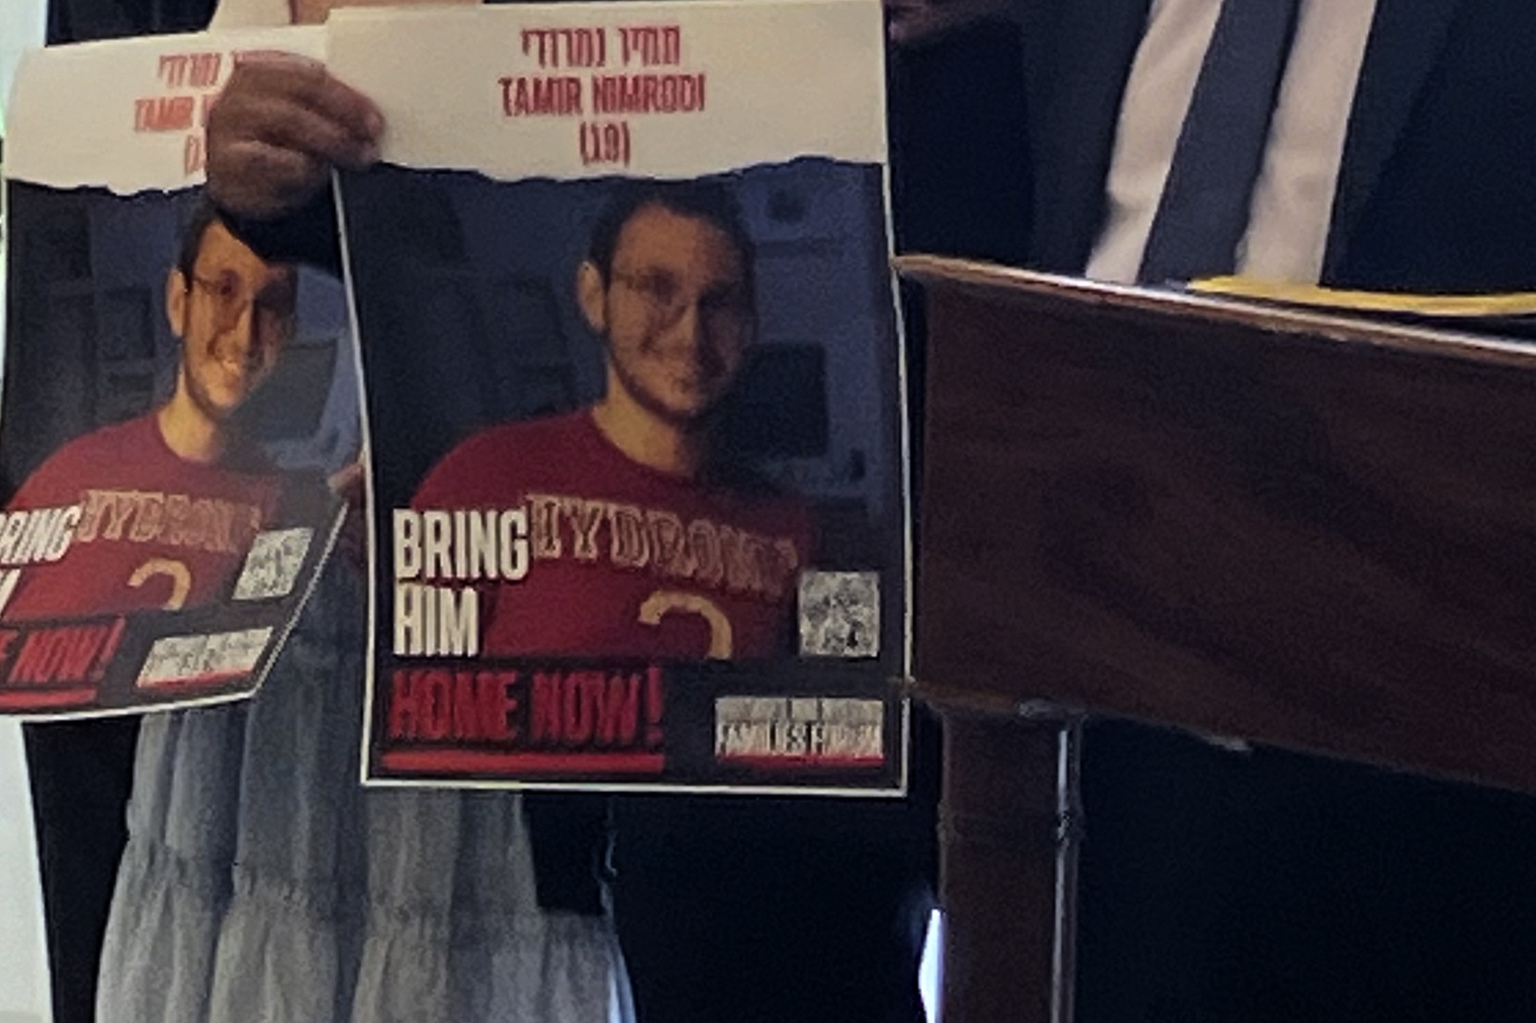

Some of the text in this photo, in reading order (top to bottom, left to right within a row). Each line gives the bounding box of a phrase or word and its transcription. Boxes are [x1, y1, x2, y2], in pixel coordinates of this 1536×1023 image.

[520, 24, 682, 69] תמיר נמרודי
[498, 73, 706, 117] TAMIR NIMRODI
[0, 505, 82, 565] RING
[392, 506, 529, 582] BRING
[392, 580, 479, 659] HIM
[388, 666, 663, 746] HOME NOW!
